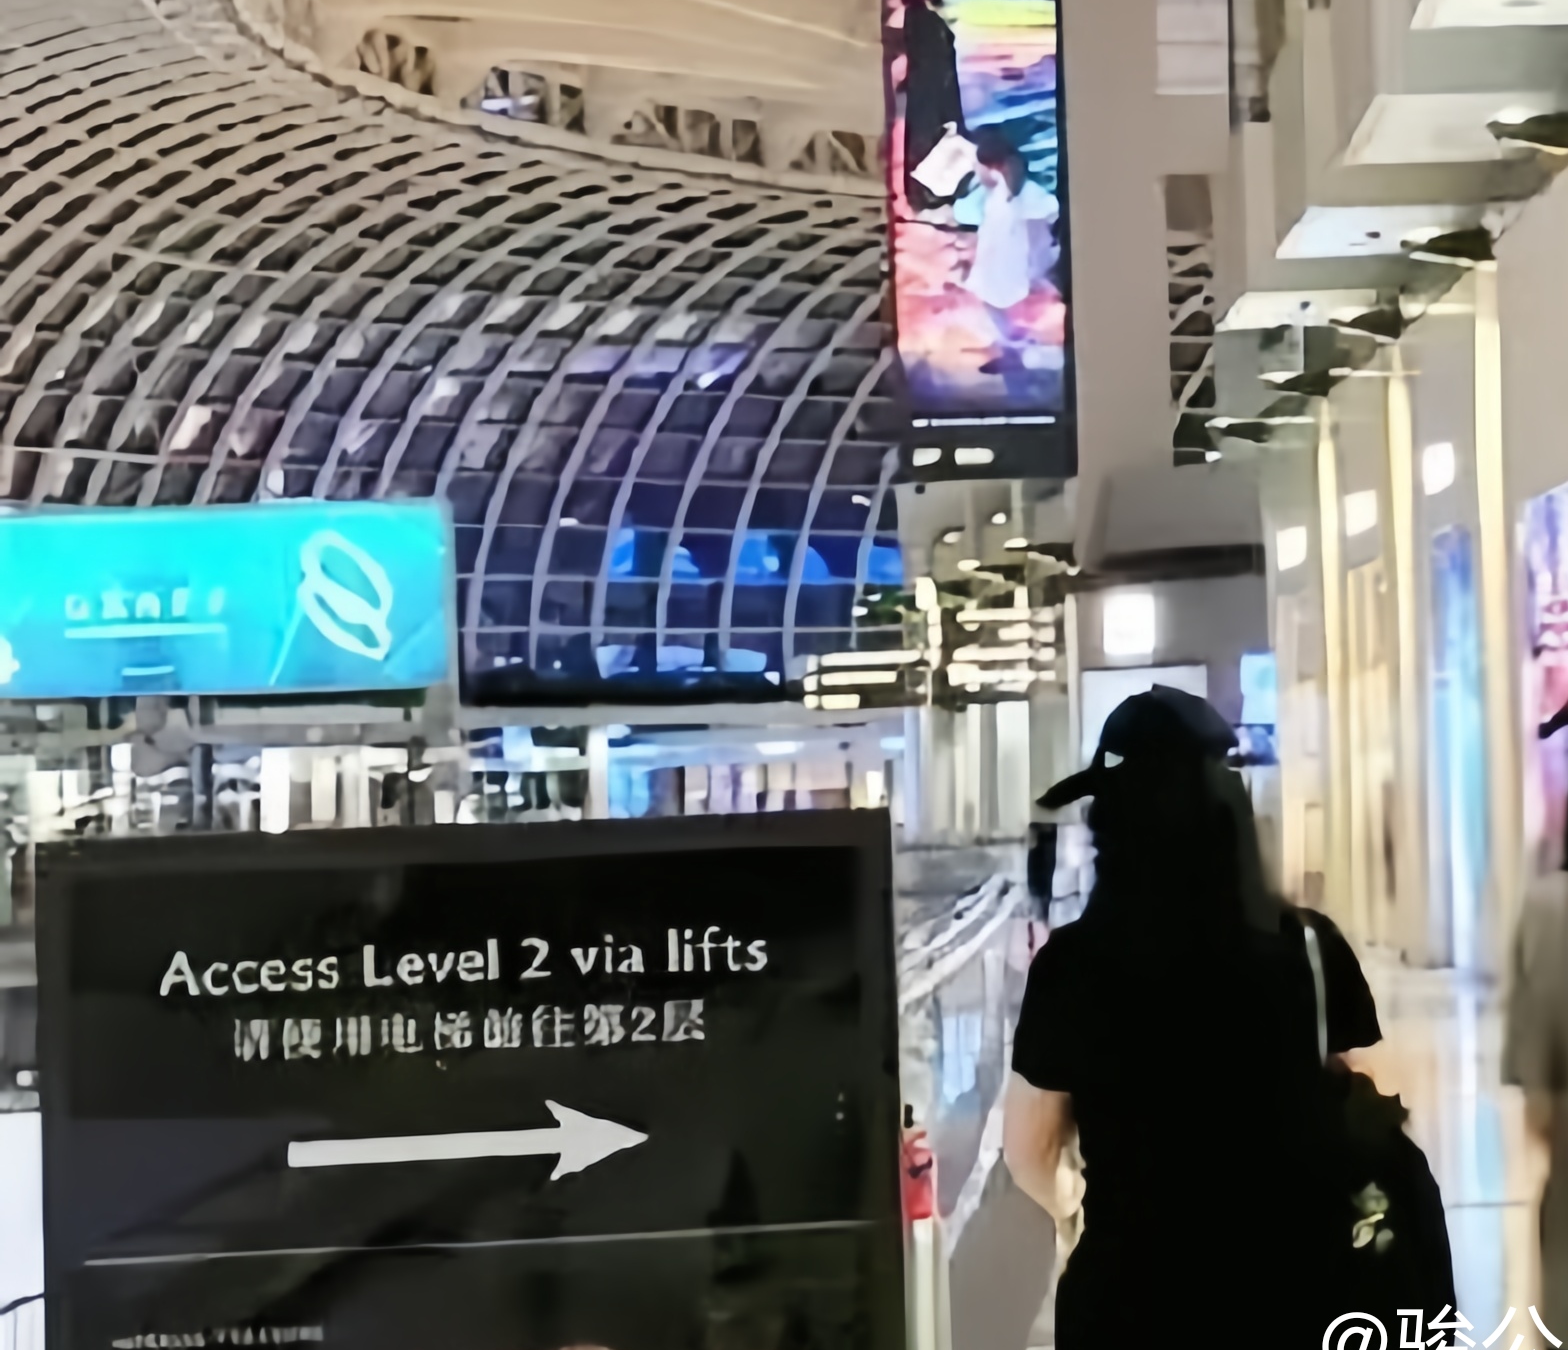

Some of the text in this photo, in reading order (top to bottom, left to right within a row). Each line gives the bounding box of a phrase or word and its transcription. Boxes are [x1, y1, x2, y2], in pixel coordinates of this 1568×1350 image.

[159, 925, 768, 997] Access Level 2 via lifts
